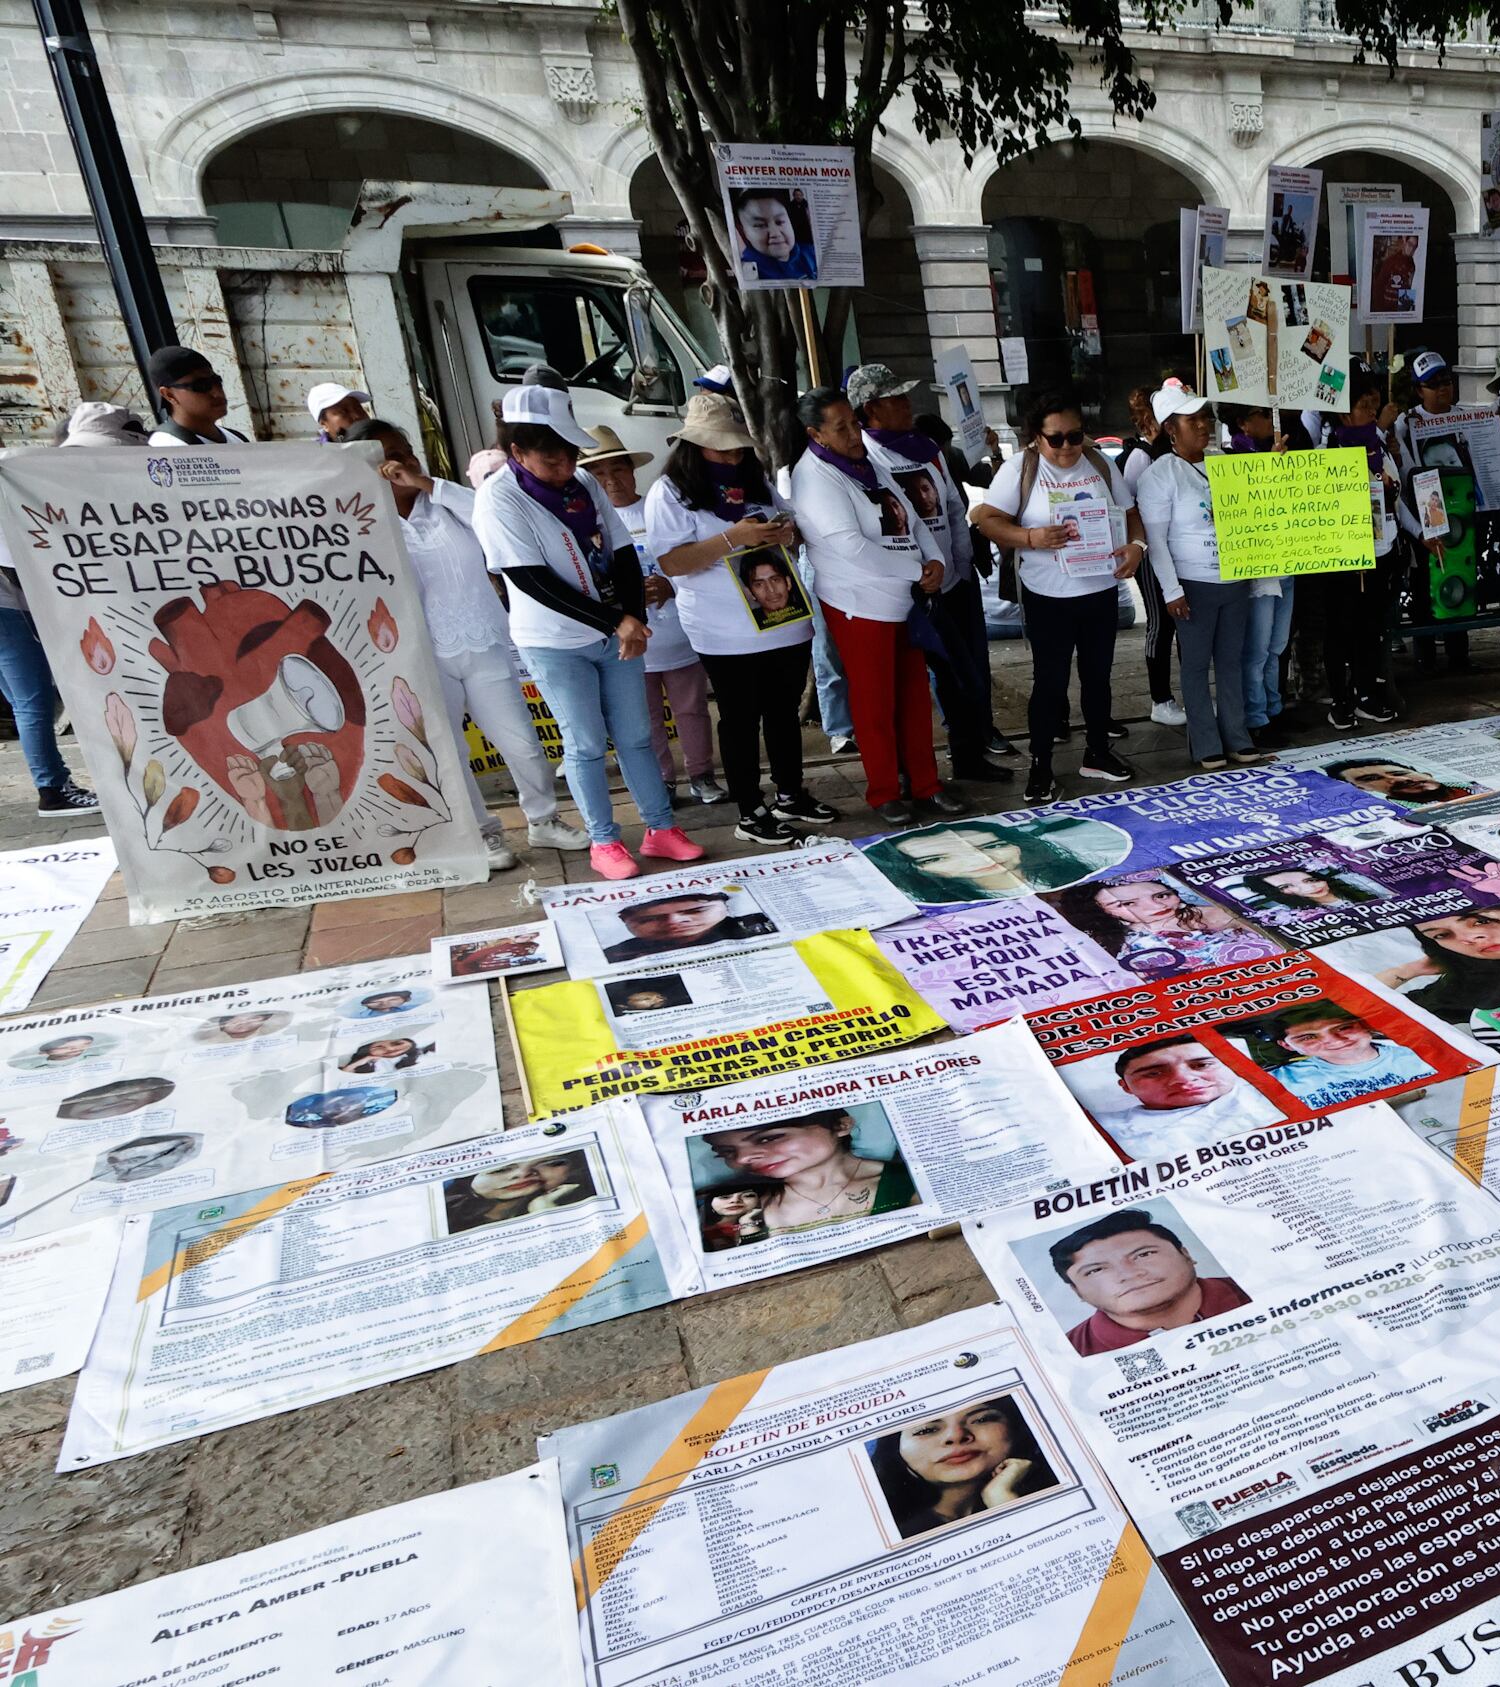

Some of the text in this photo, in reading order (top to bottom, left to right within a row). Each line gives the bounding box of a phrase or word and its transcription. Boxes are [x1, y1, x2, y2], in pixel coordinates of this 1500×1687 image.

[725, 165, 850, 177] JENYFER ROMÁN MOYA
[172, 456, 214, 464] COLECTIVO
[1211, 453, 1327, 478] NI UNA MADRE
[1039, 474, 1101, 490] DESAPARECIDO
[1220, 494, 1240, 507] UN
[1248, 486, 1303, 503] MINUTO
[1307, 484, 1322, 496] DE
[80, 494, 327, 527] A LAS PERSONAS
[1219, 500, 1340, 522] PARA Aida KARINA
[1341, 515, 1359, 526] DE
[62, 523, 350, 558] DESAPARECIDAS
[52, 550, 395, 597] SE LES BUSCA,
[1233, 564, 1279, 577] HASTA
[1003, 769, 1265, 824] DESAPARECIDA
[1126, 775, 1299, 817] LUCERO
[269, 836, 349, 857] NO SE
[1169, 805, 1397, 860] NI UNA MENOS
[208, 868, 439, 905] AGOSTO INTERNACIONAL DE
[1357, 885, 1465, 922] Poderosas
[886, 910, 1056, 953] TRANQUILA
[1375, 896, 1473, 932] sin Miedo
[912, 925, 1062, 965] HERMANA
[970, 941, 1042, 970] AQUÍ
[953, 965, 1037, 992] ESTA
[1164, 950, 1309, 995] JUSTICIA!
[132, 987, 250, 1014] INDÍGENAS
[290, 984, 351, 1001] mayo
[640, 1006, 873, 1062] SEGUIMOS BUSCANDO!
[1046, 984, 1322, 1061] DESAPARECIDOS
[1090, 1008, 1160, 1037] LOS
[562, 1005, 912, 1091] PEDRO ROMÁN CASTILLO
[591, 1023, 902, 1104] ¡NOS FALTAS PEDRO!
[682, 1053, 982, 1124] KARLA ALEJANDRA TELA FLORES
[1033, 1115, 1334, 1221] BOLETÍN DE BÚSQUEDA
[1111, 1141, 1309, 1207] GUSTAVO SOLANO FLORES
[1184, 1307, 1268, 1351] ¿Tienes
[1268, 1262, 1407, 1318] información?
[1107, 1364, 1198, 1400] BUZÓN DE PAZ
[691, 1402, 927, 1481] KARLA ALEJANDRA TELA FLORES
[703, 1421, 811, 1460] BOLETÍN DE
[1128, 1434, 1194, 1464] VESTIMENTA
[1156, 1420, 1273, 1474] Pantalón mezclilla
[1310, 1442, 1378, 1475] Búsqueda
[1170, 1429, 1341, 1503] FECHA ELABORACIÓN: 17/05/2025
[1179, 1553, 1203, 1572] Si
[1203, 1541, 1236, 1566] los
[1236, 1491, 1357, 1552] desapareces
[1357, 1466, 1410, 1498] dejalos
[1413, 1447, 1474, 1476] donde
[1212, 1470, 1294, 1512] PUEBLA
[702, 1519, 742, 1535] DELGADA
[790, 1551, 933, 1608] CARPETA INVESTIGACIÓN
[1240, 1613, 1275, 1637] No
[1277, 1571, 1384, 1629] perdamos
[1385, 1550, 1418, 1576] las
[335, 1602, 433, 1637] EDAD: 17 AÑOS
[1250, 1635, 1283, 1660] Tu
[1286, 1561, 1449, 1648] colaboración
[1452, 1551, 1477, 1570] es
[161, 1631, 284, 1680] DE NACIMIENTO:
[334, 1626, 467, 1675] GÉNERO: MASCULINO
[608, 1635, 651, 1653] MENTÓN:
[1269, 1631, 1357, 1681] Ayuda
[1358, 1623, 1375, 1641] a
[1377, 1604, 1418, 1633] que
